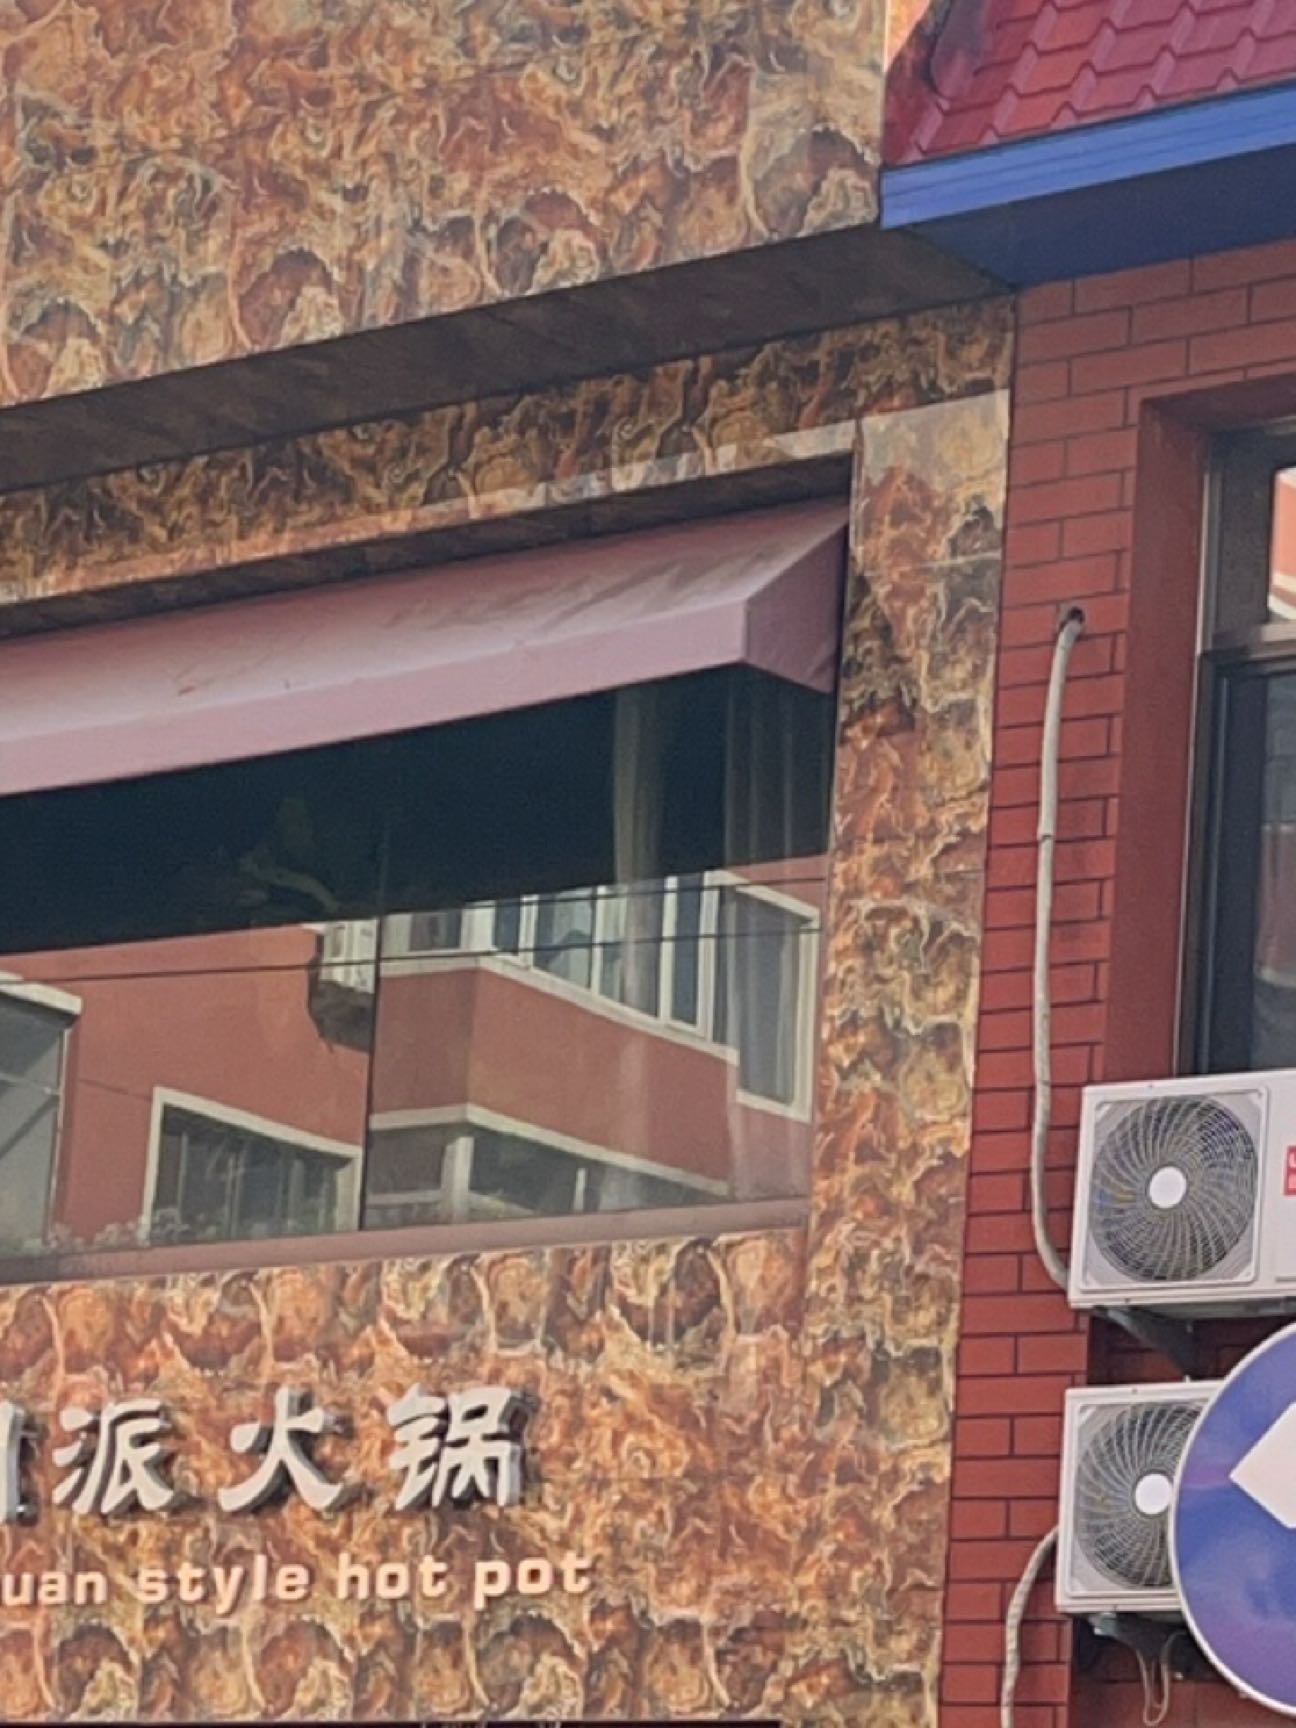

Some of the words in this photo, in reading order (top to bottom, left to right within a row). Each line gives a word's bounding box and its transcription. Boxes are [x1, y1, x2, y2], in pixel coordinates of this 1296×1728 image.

[136, 1555, 311, 1614] style
[337, 1552, 448, 1601] hot
[474, 1551, 593, 1610] pot
